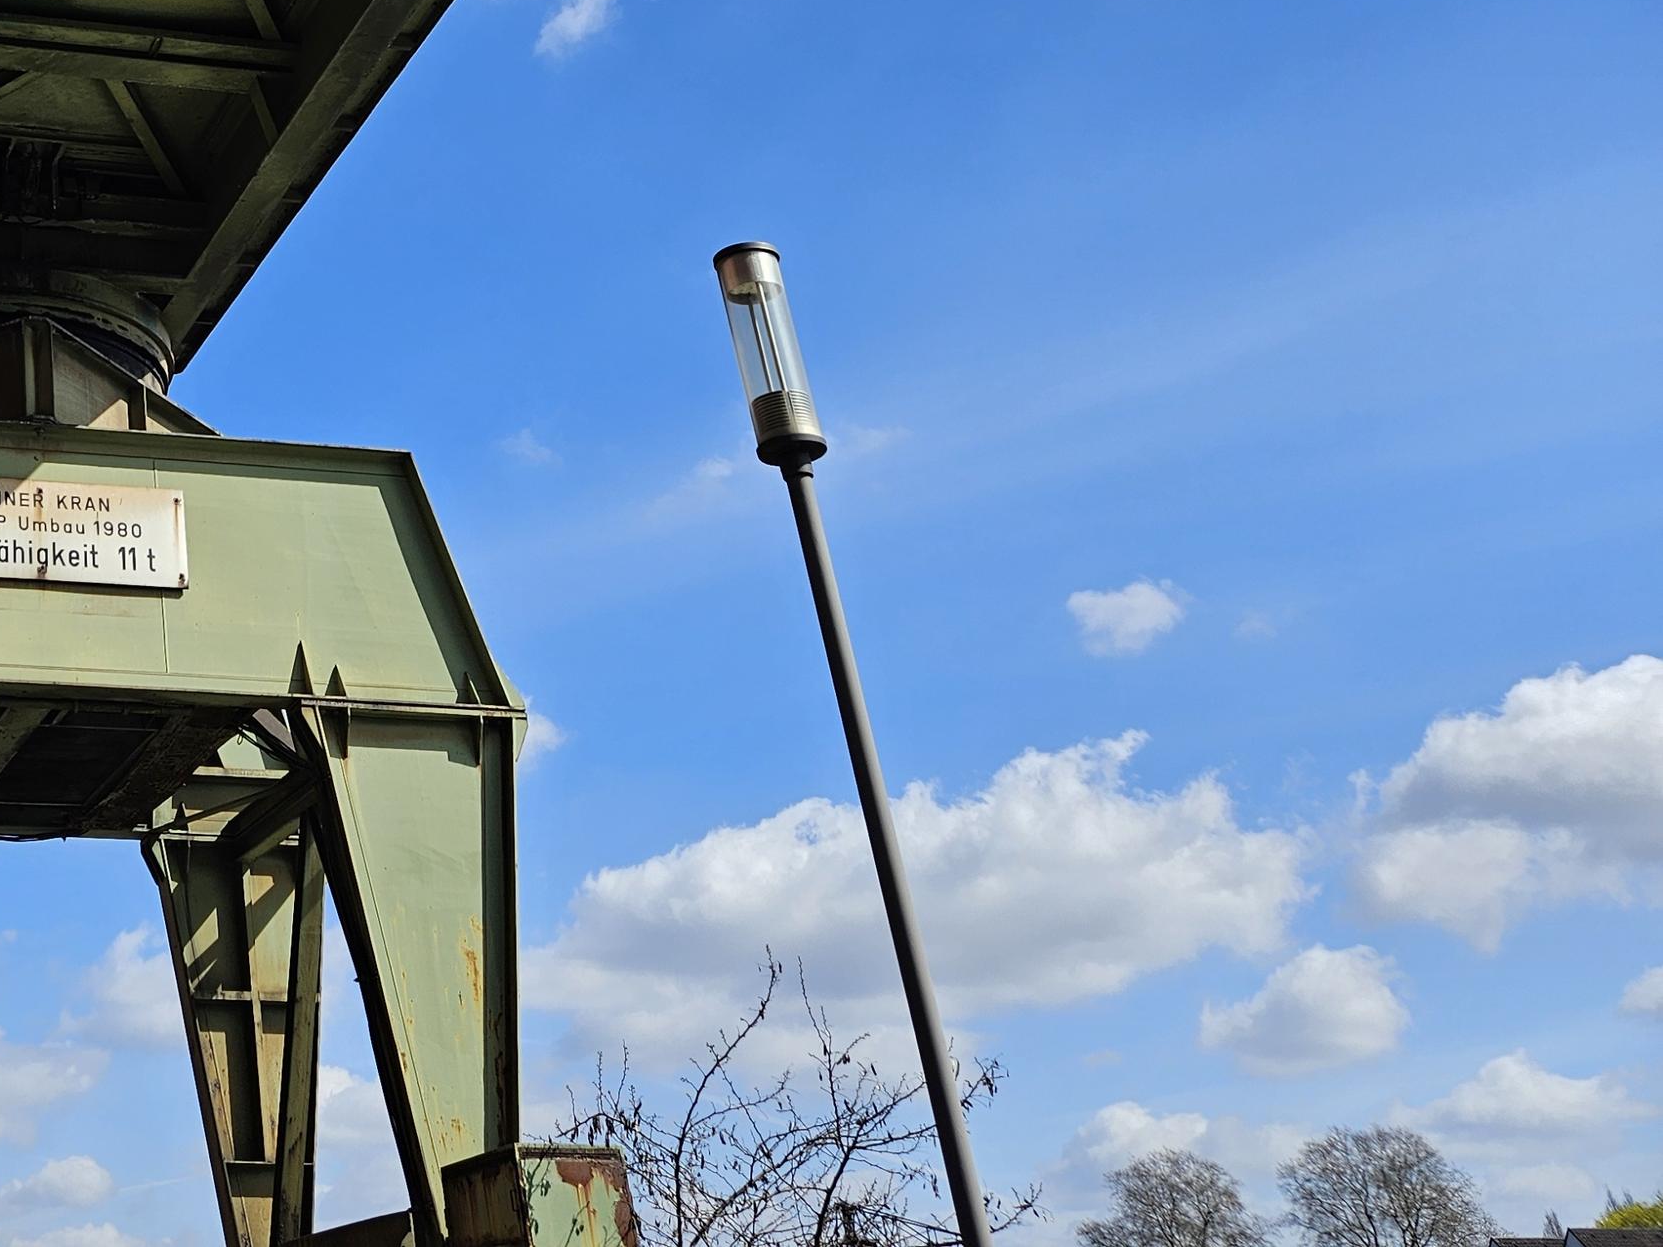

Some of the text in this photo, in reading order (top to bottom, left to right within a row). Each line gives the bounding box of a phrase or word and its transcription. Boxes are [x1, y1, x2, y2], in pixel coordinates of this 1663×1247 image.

[56, 494, 111, 513] KRAN
[18, 515, 86, 535] Umbau
[94, 520, 143, 539] 1980
[117, 545, 138, 572] 11
[147, 547, 157, 573] t
